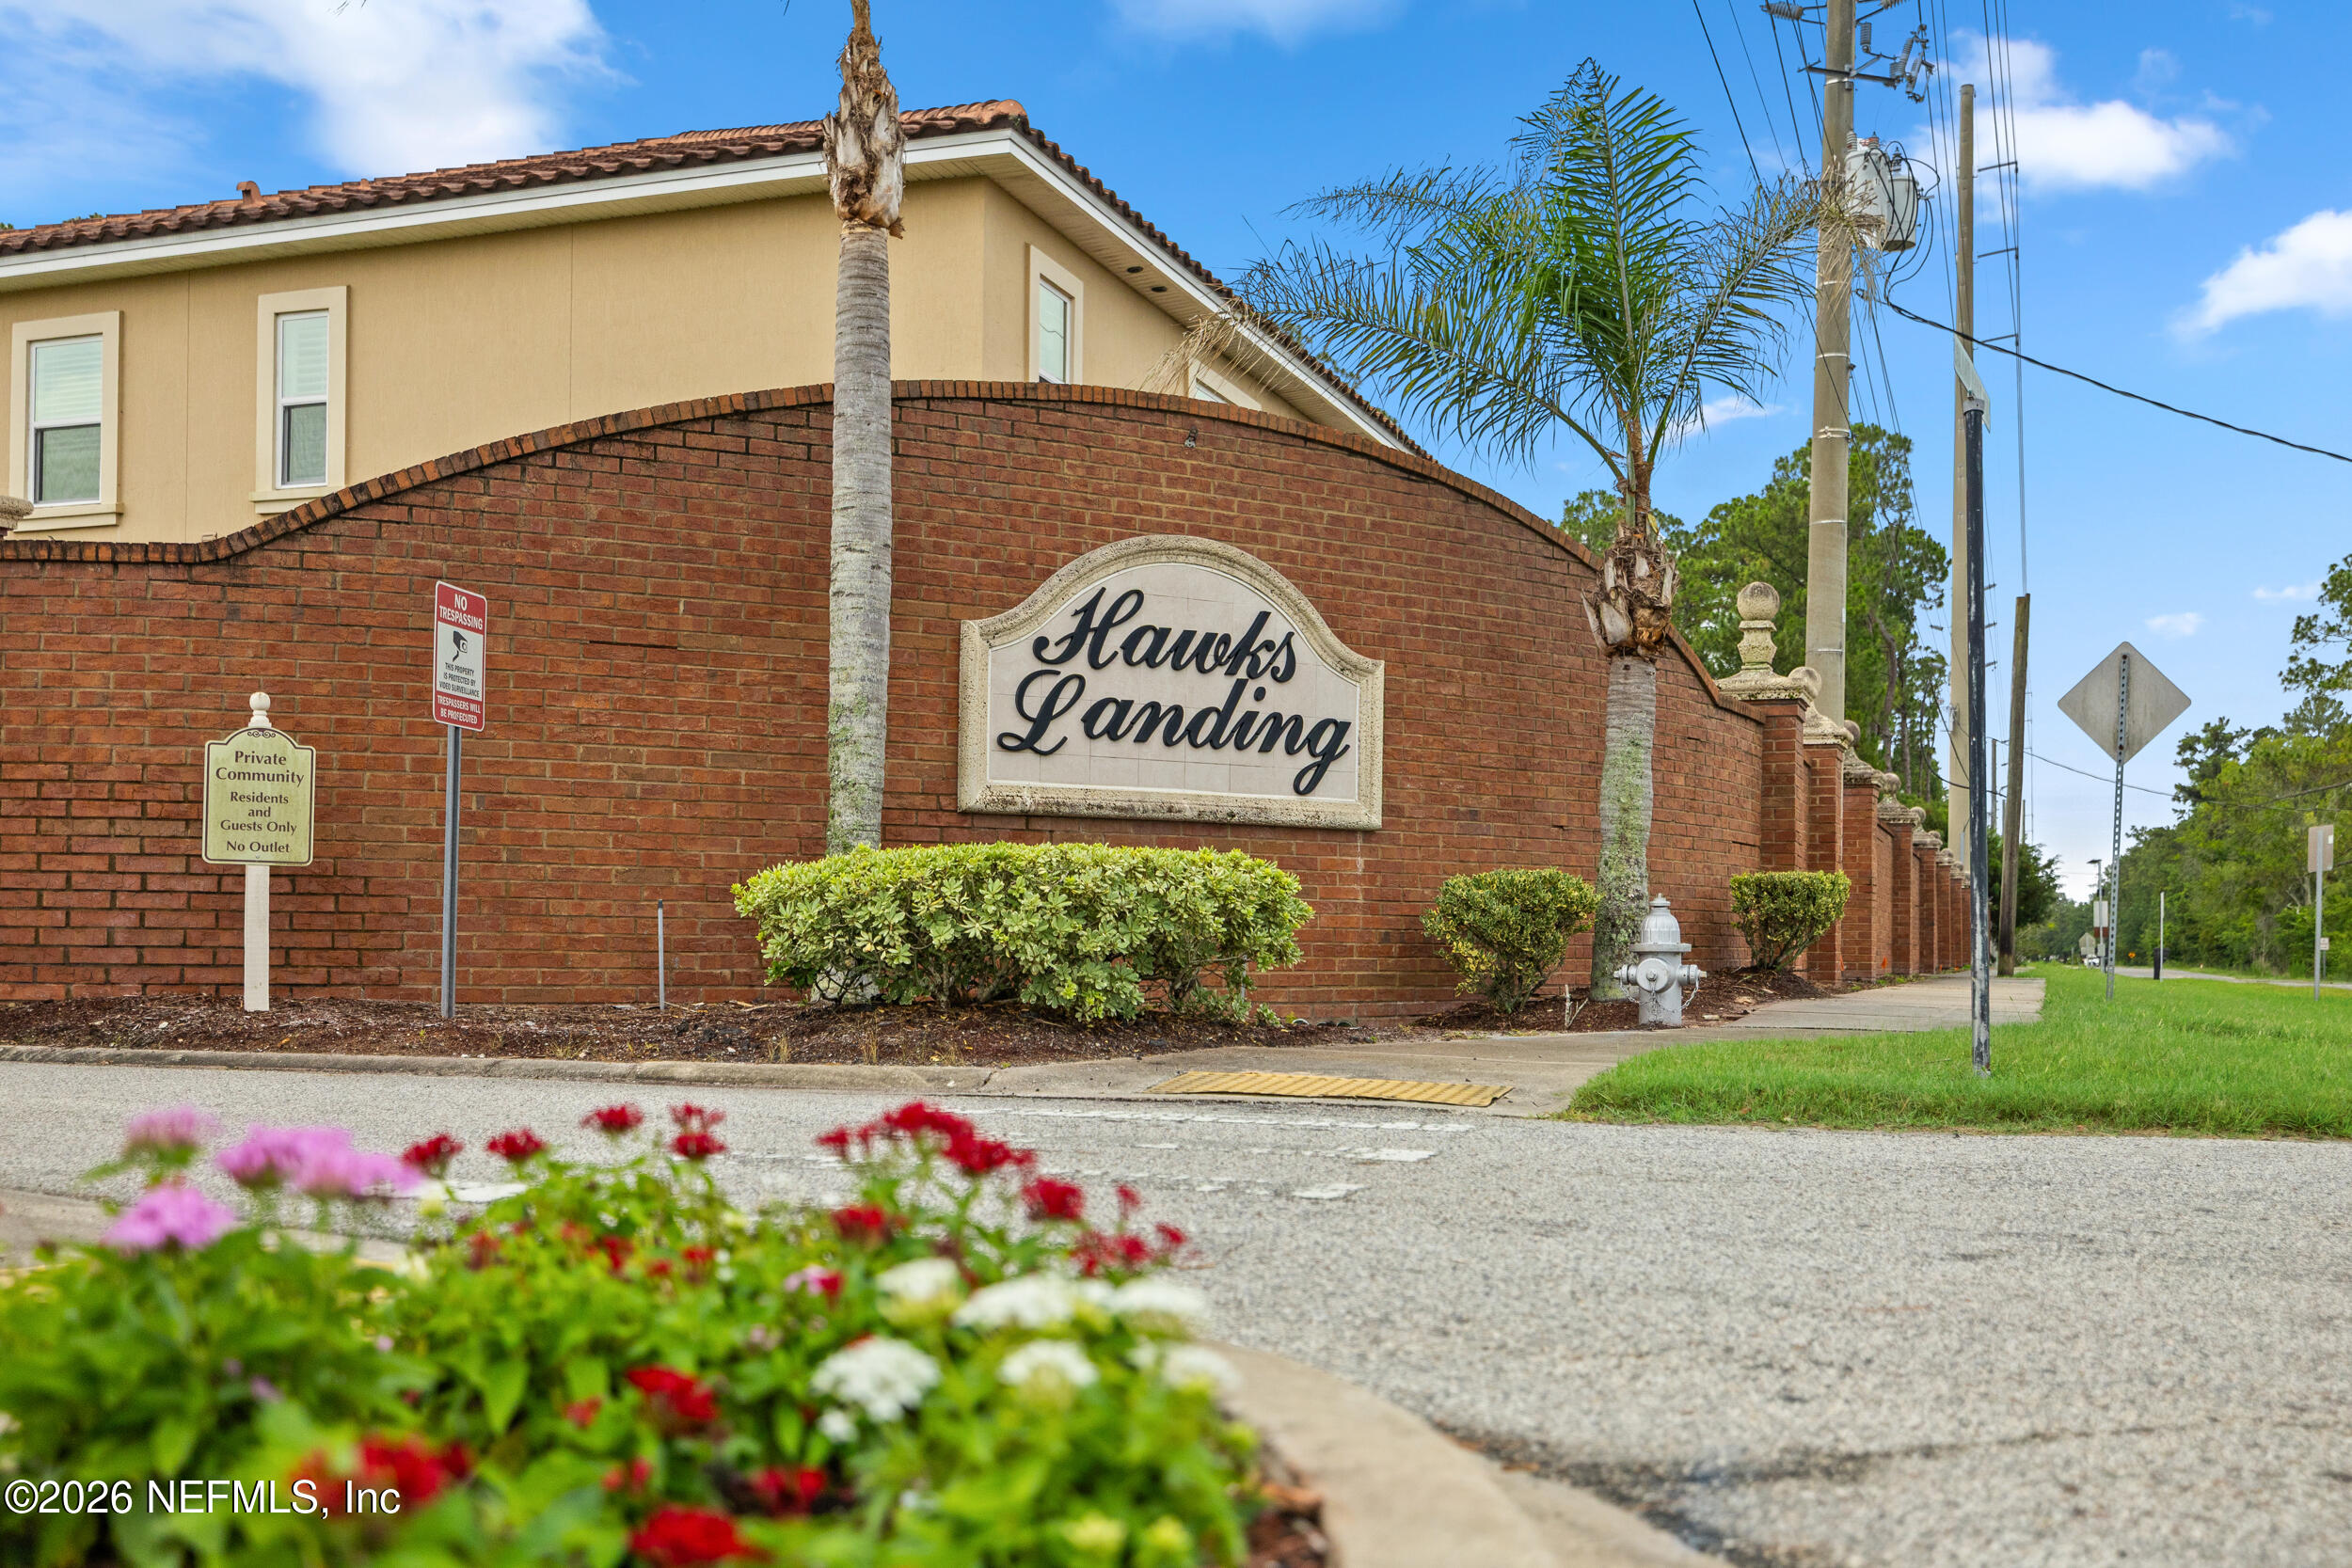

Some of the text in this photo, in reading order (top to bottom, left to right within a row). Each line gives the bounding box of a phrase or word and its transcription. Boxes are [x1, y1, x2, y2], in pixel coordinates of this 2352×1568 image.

[454, 594, 468, 611] NO
[438, 605, 483, 630] TRESPASSING
[1032, 586, 1296, 684] Hawks
[445, 662, 474, 677] THIS PROPERTY
[448, 673, 469, 685] PROTECTED
[470, 678, 476, 687] BY
[439, 680, 480, 698] VIDEO SURVEILLANCE
[437, 694, 481, 714] TRESPASSERS WILL
[440, 707, 478, 724] BE PROSECUTED
[996, 669, 1352, 796] Landing
[234, 751, 287, 766] Private
[215, 767, 305, 788] Community
[230, 791, 289, 804] Residents
[247, 806, 271, 817] and
[220, 819, 297, 835] Guests Only
[226, 840, 290, 853] No Outlet
